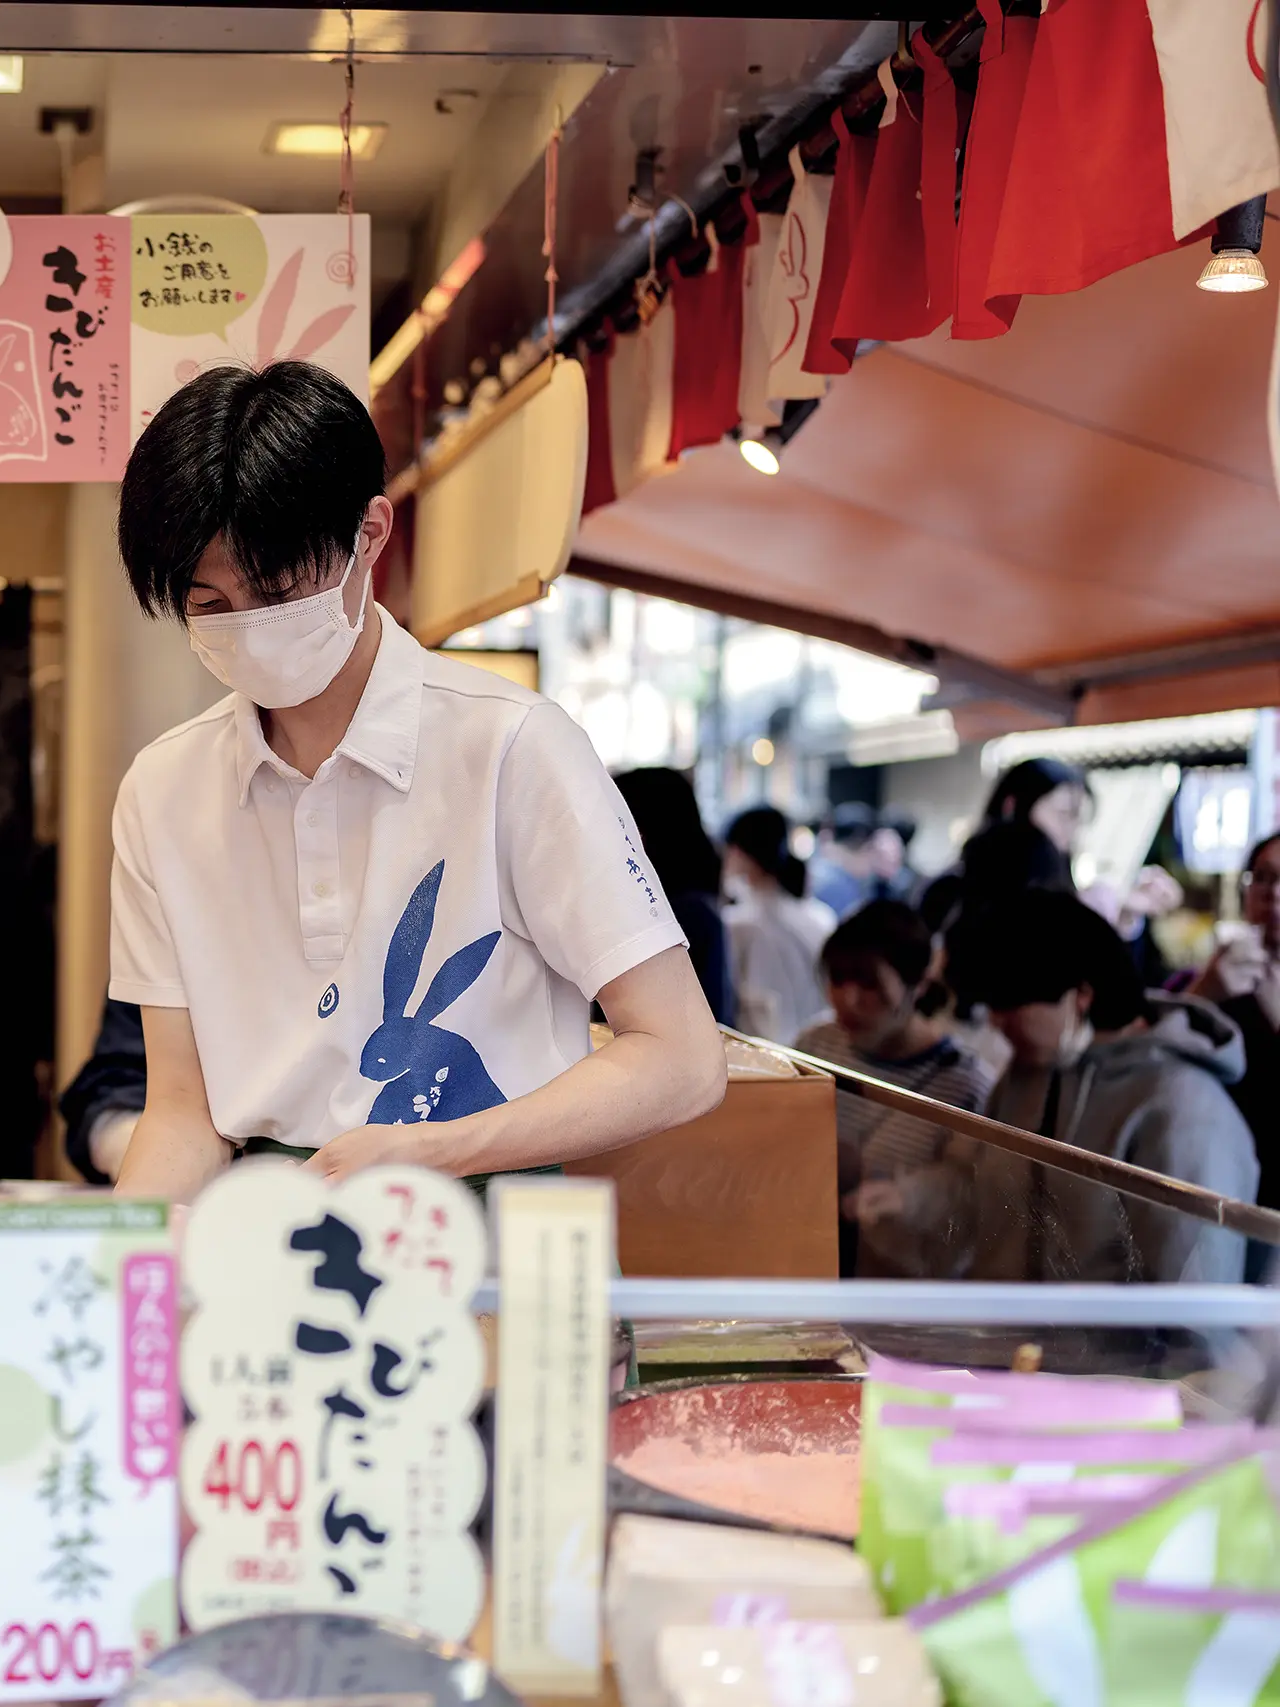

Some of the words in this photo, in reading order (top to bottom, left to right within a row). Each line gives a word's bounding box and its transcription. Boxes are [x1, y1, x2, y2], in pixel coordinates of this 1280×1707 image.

[93, 233, 116, 299] お土産
[136, 232, 214, 257] 小銭の
[139, 288, 232, 308] お願いします
[42, 245, 109, 446] きびだんご
[32, 1256, 113, 1604] 冷やし抹茶
[203, 1439, 304, 1512] 400
